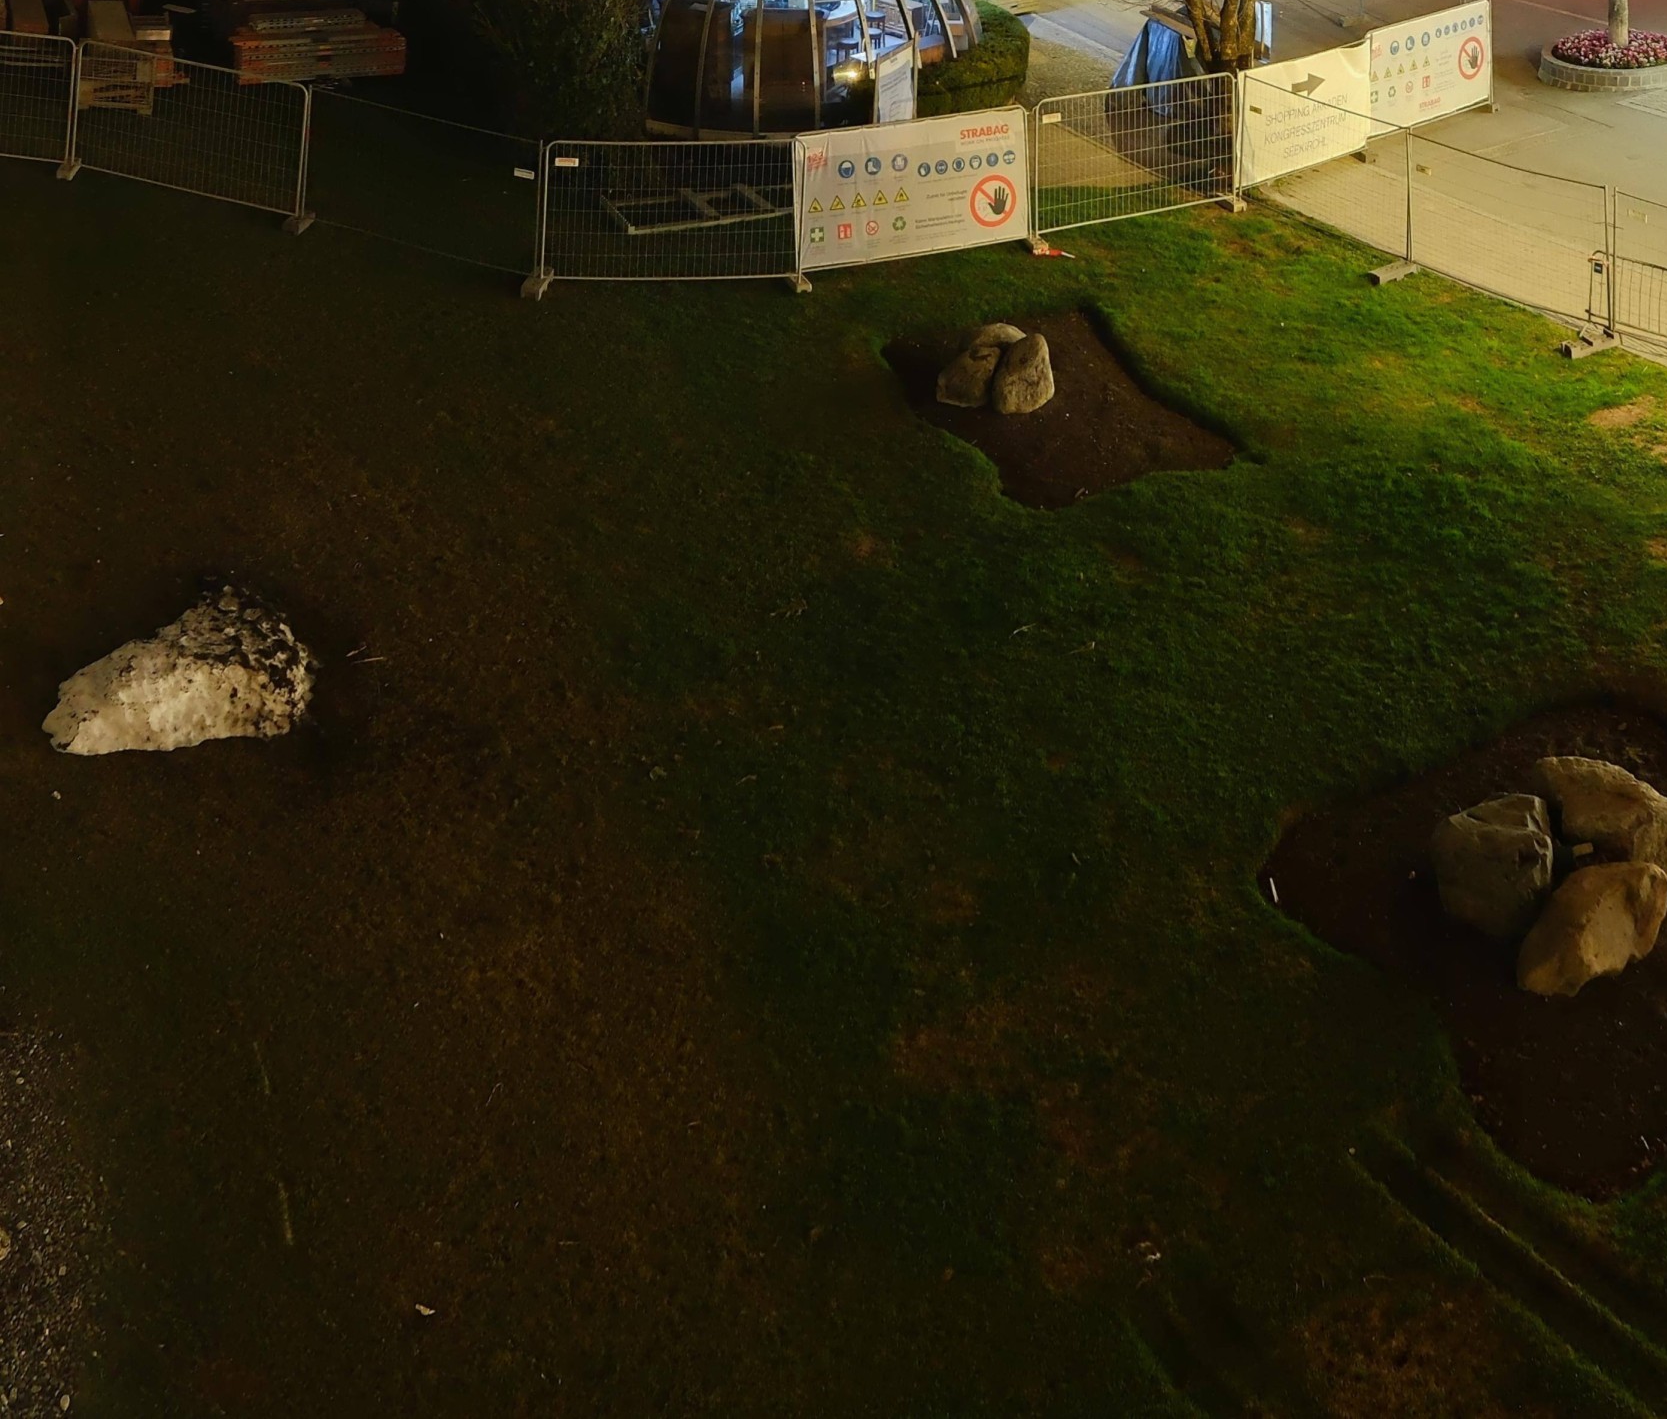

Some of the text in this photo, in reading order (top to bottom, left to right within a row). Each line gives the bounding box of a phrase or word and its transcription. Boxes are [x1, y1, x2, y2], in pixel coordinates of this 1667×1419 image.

[1265, 105, 1310, 127] SHOPPING
[960, 123, 1009, 140] STRABAG
[1264, 111, 1347, 147] KONGRESSZENTRUM
